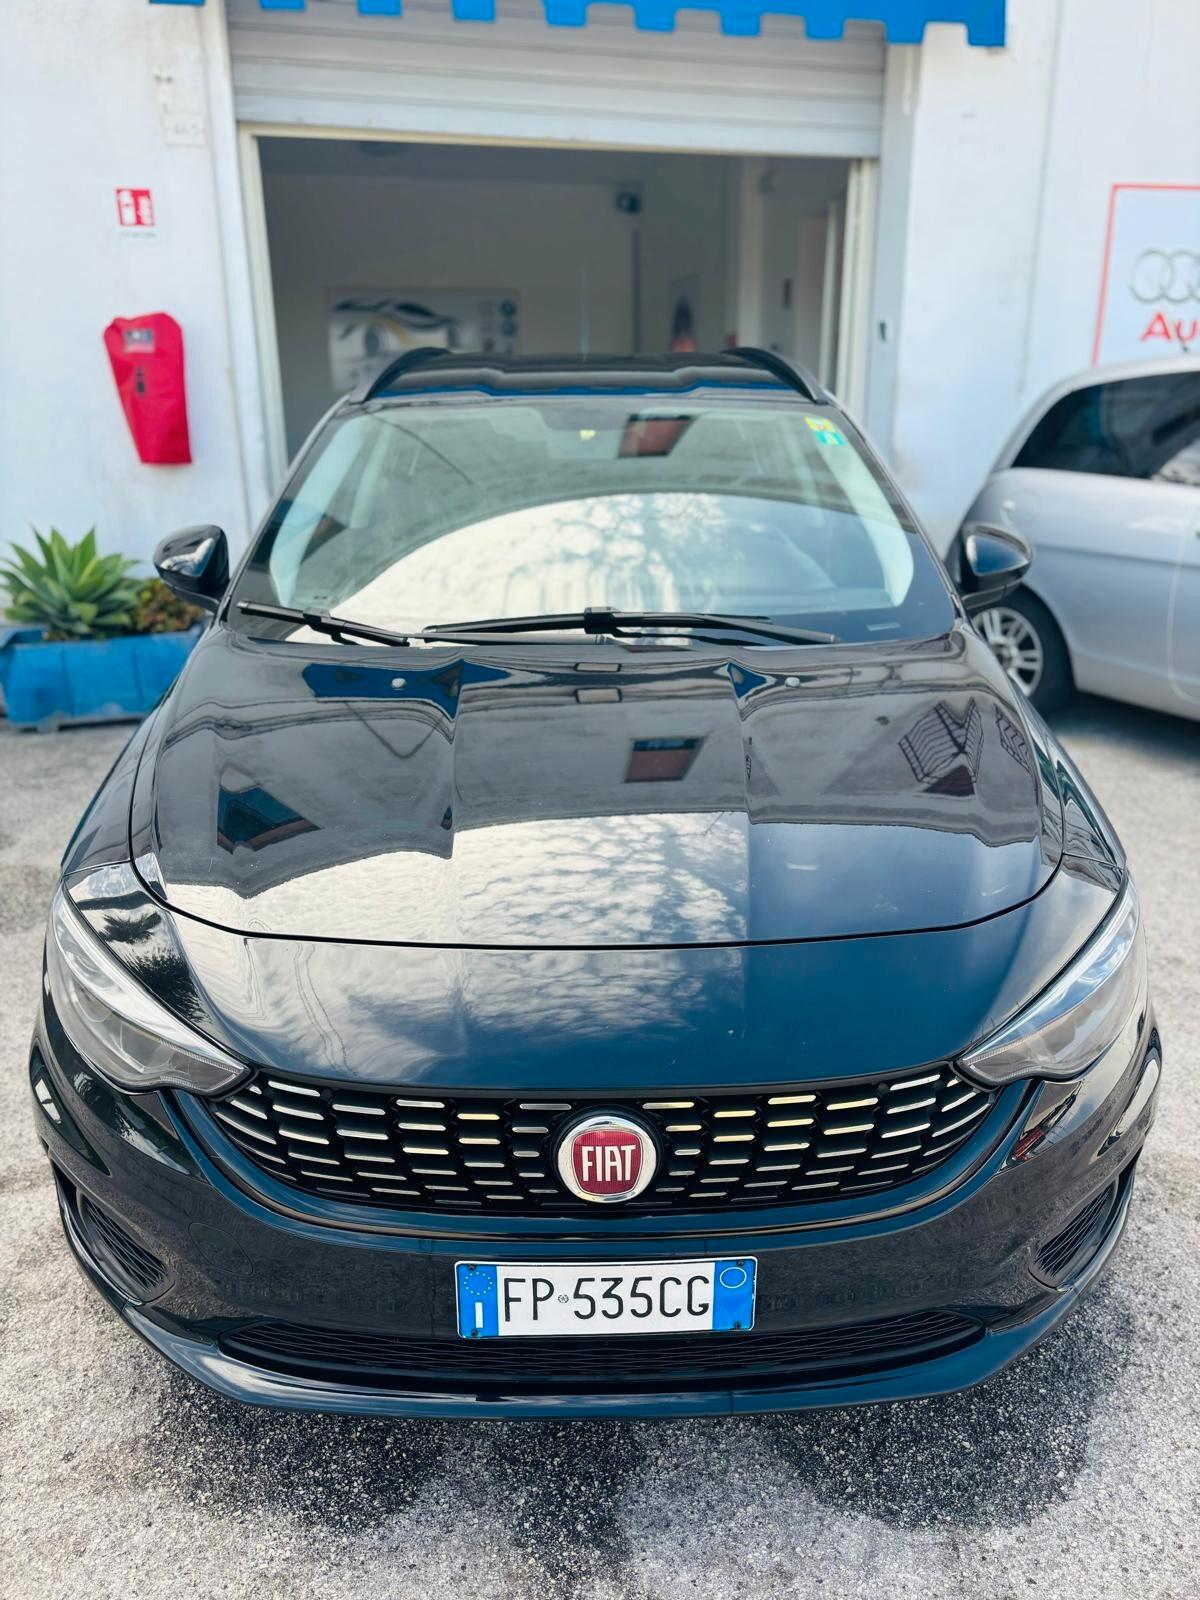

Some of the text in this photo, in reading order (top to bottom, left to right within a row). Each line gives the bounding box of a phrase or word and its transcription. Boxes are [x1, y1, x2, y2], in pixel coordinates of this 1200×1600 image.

[581, 1144, 636, 1182] FIAT
[504, 1275, 709, 1322] FP 535CG
